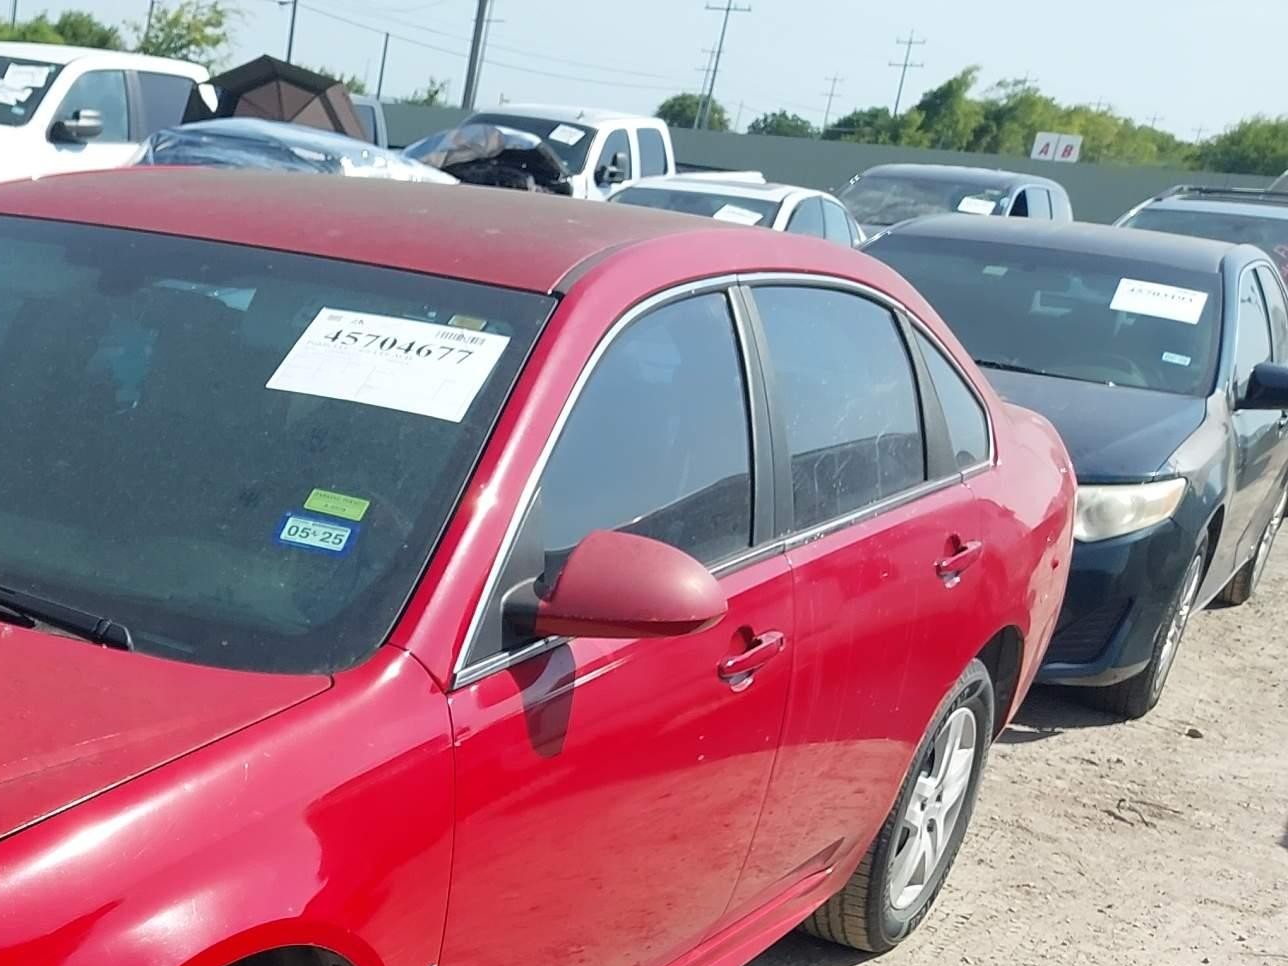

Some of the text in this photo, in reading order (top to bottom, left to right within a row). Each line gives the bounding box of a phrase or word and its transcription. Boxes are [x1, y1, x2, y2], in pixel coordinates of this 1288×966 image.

[1038, 142, 1050, 156] A
[1061, 144, 1074, 158] B
[324, 329, 475, 364] 45704677
[287, 525, 344, 546] 05 25
